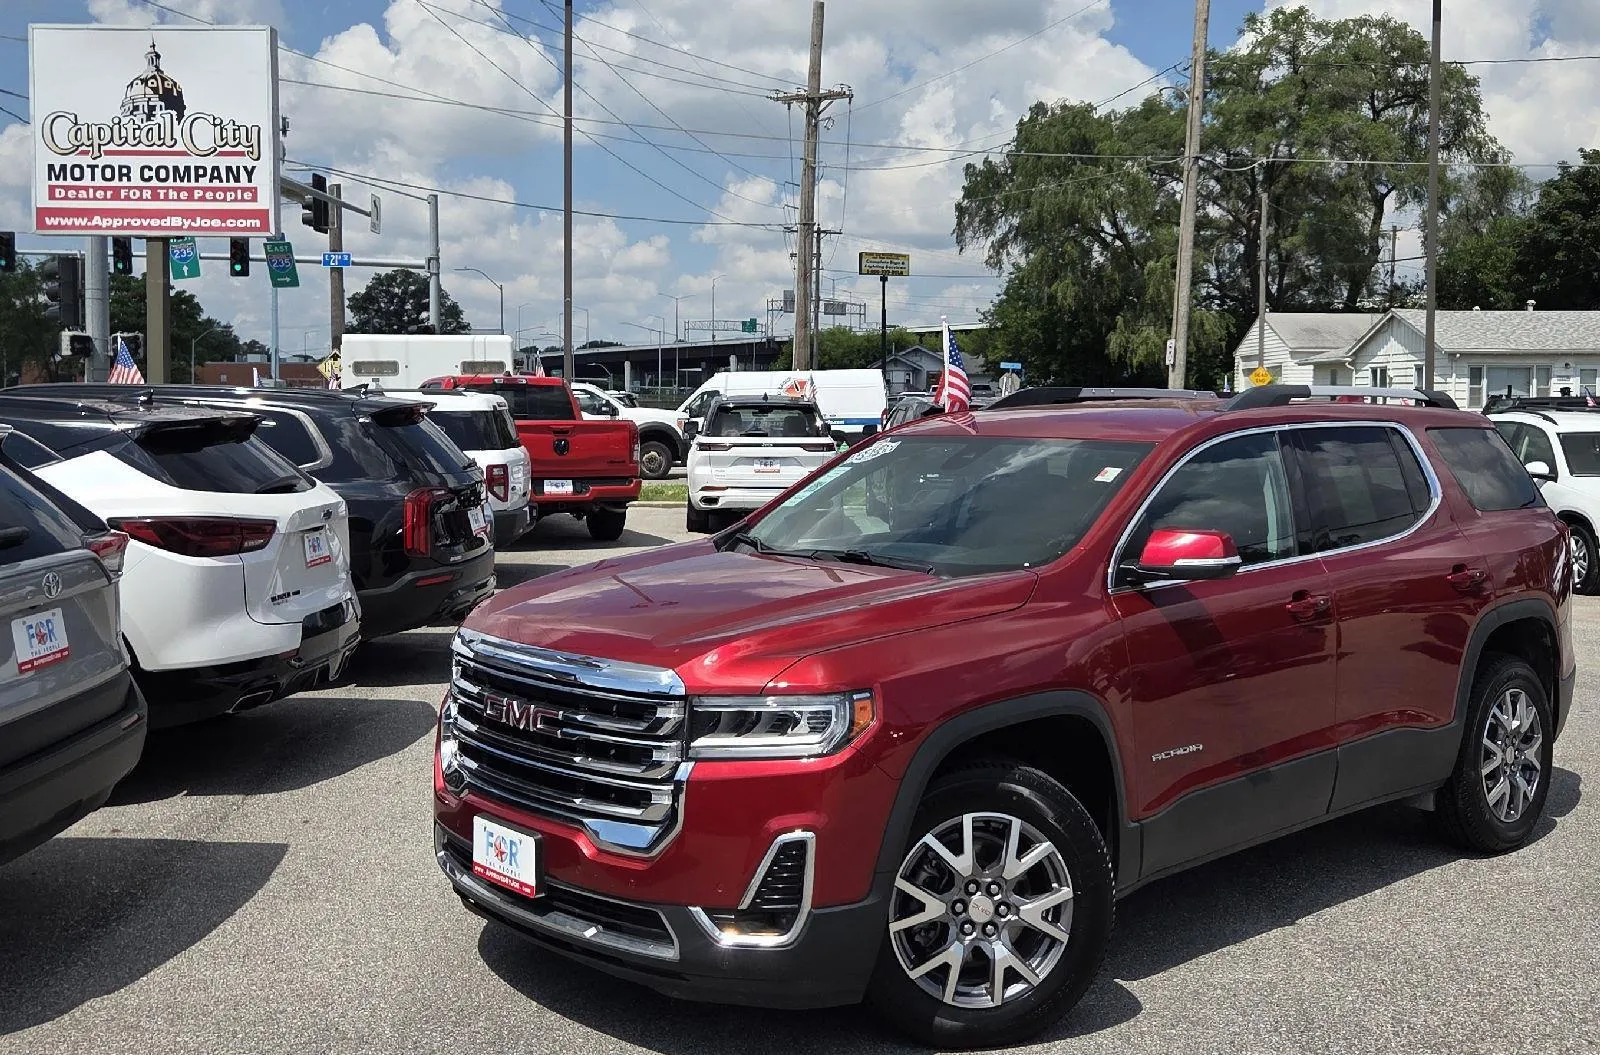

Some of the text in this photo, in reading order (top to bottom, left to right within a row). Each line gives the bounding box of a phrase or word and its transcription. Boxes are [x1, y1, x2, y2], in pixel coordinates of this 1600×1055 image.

[42, 111, 260, 160] Capital City
[47, 164, 257, 183] MOTOR COMPANY
[55, 188, 253, 202] Dealer FOR The People
[44, 215, 261, 229] www.ApprovedByJoe.com
[173, 248, 194, 258] 235
[267, 244, 289, 252] EAST
[271, 259, 291, 268] 235
[484, 694, 564, 739] GMC
[1152, 744, 1203, 761] ACADIA
